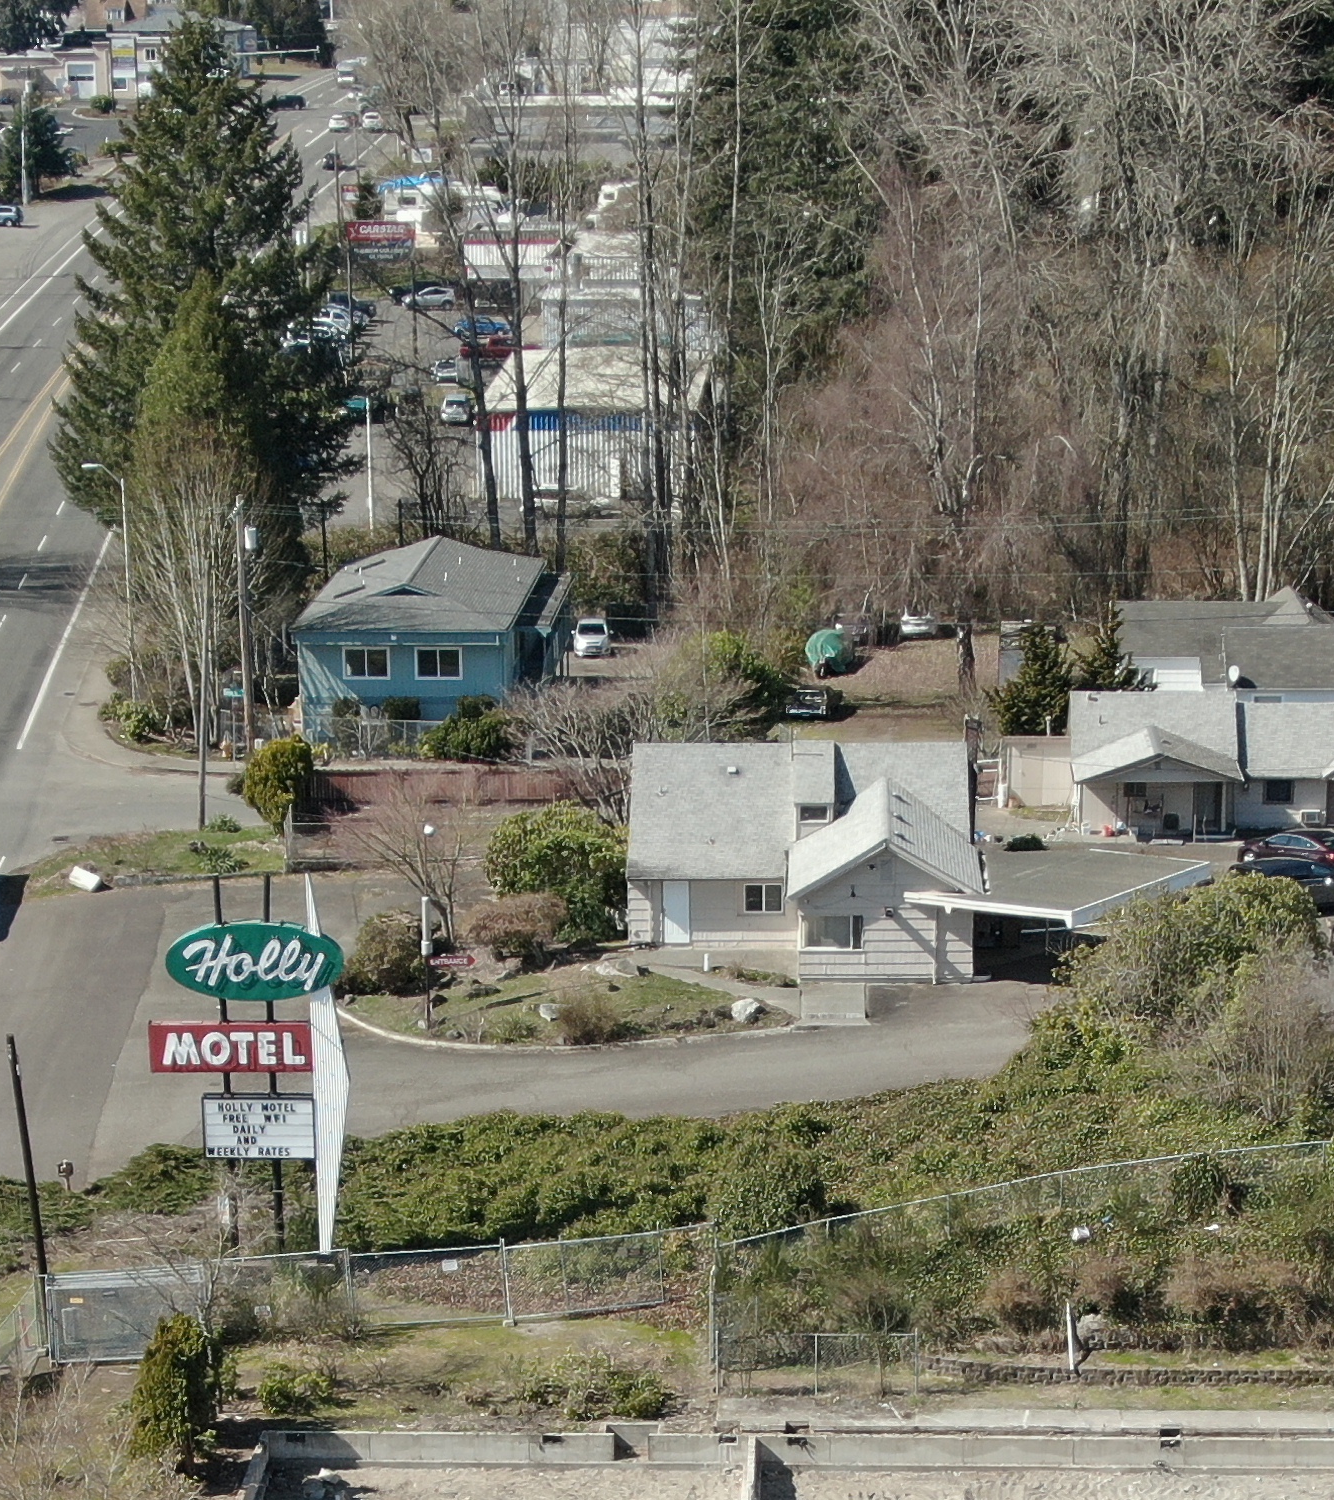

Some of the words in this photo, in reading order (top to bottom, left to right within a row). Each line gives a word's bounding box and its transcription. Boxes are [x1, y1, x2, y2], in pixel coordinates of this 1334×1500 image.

[359, 224, 406, 234] CARSTAR
[182, 933, 326, 991] Holly
[162, 1031, 306, 1066] MOTEL
[218, 1103, 253, 1112] HOLLY
[261, 1103, 296, 1112] MOTEL
[222, 1114, 247, 1123] FREE
[233, 1125, 266, 1134] DAILY
[237, 1136, 257, 1145] AND
[207, 1147, 249, 1156] WEEKLY
[258, 1147, 291, 1156] RATES
